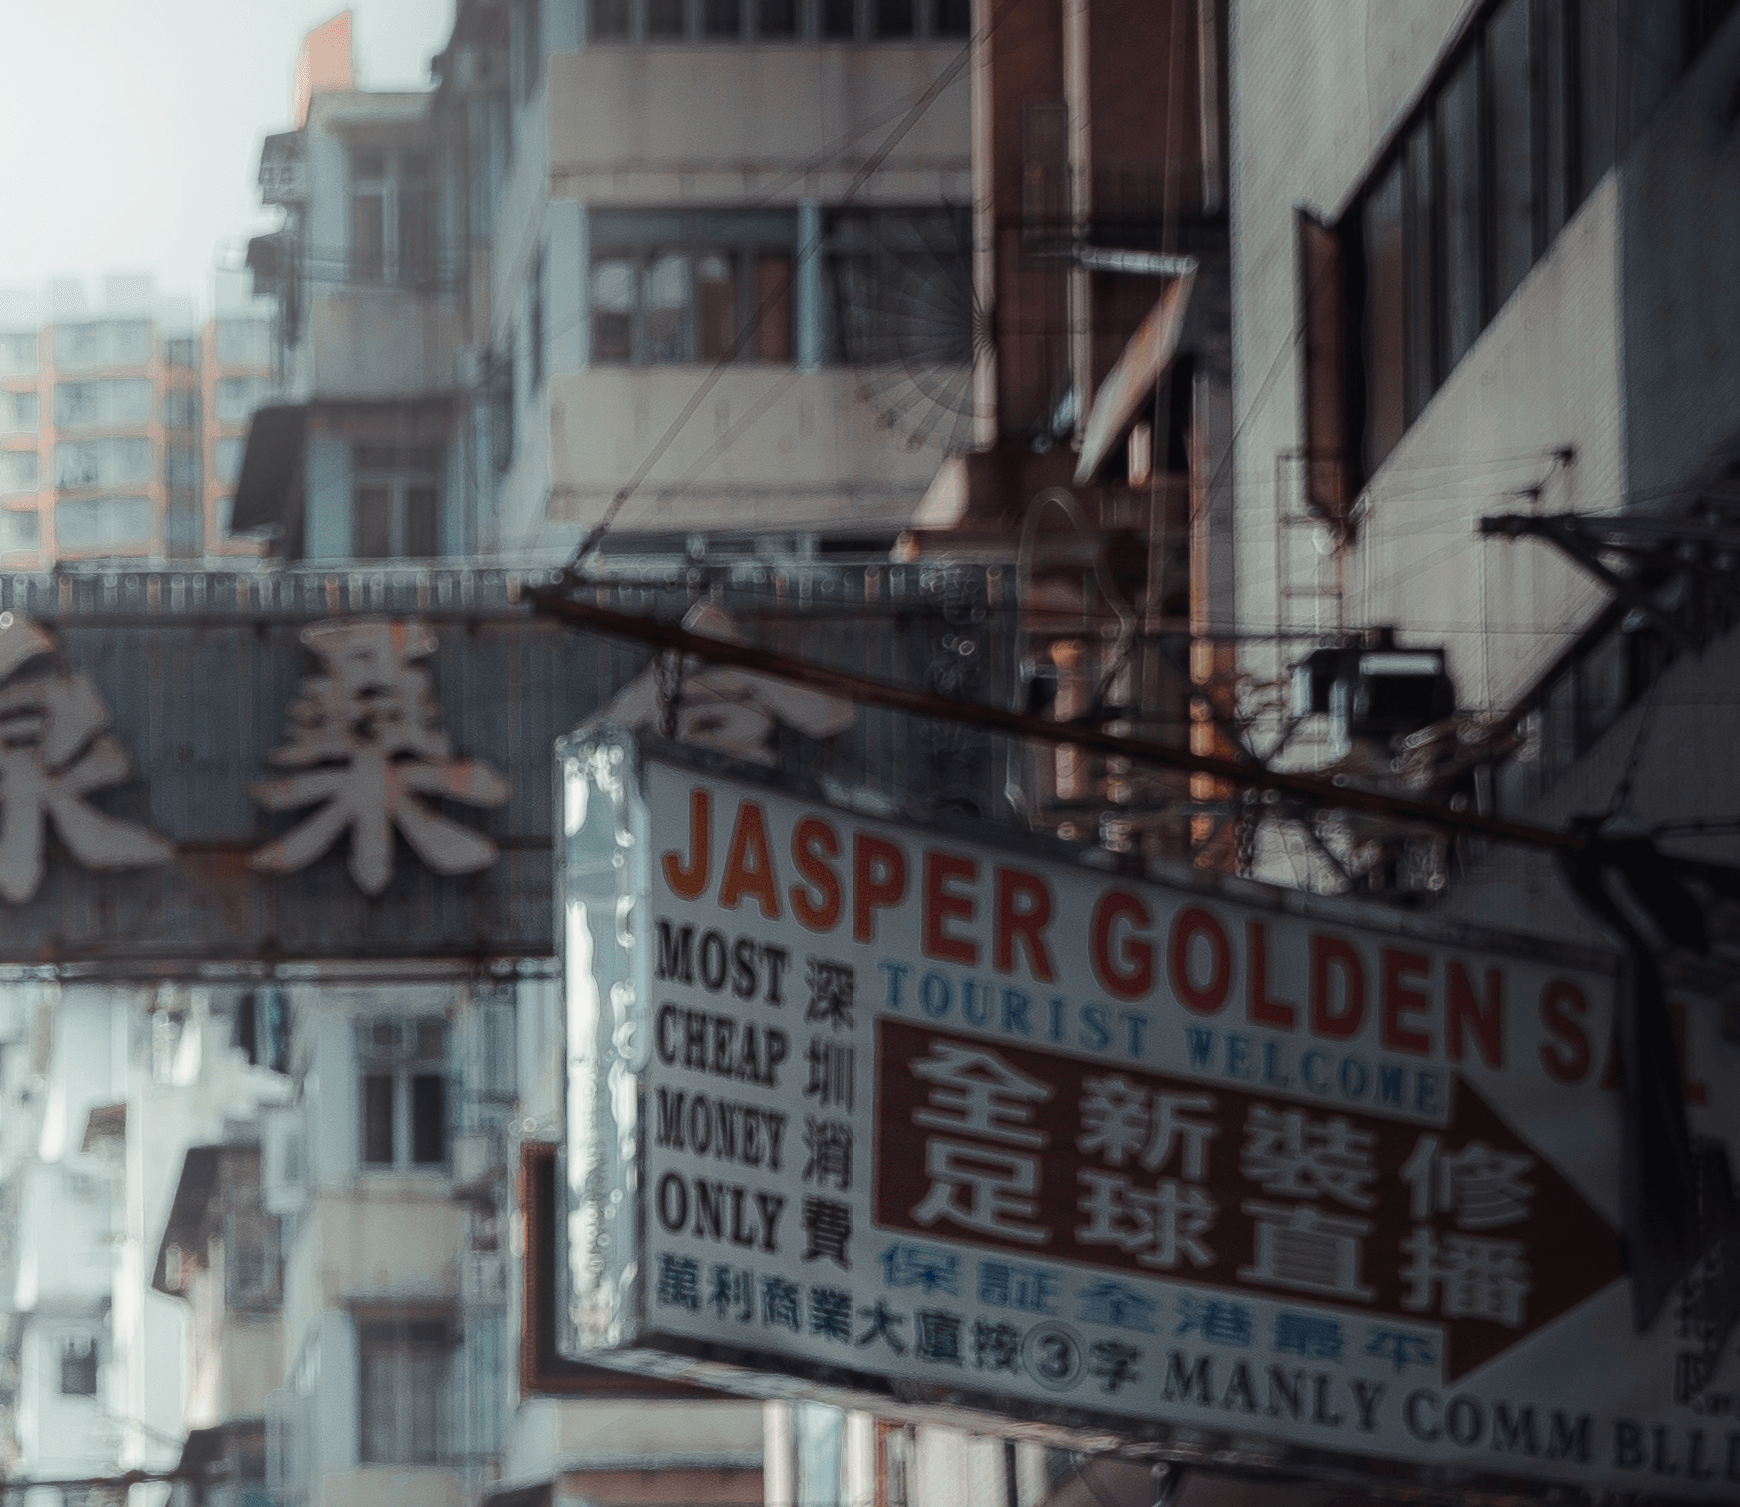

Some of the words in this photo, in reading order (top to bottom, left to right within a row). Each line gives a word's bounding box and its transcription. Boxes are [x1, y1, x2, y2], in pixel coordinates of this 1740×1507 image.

[655, 921, 789, 1007] MOST
[660, 788, 1058, 984] JASPER
[1087, 887, 1506, 1072] GOLDEN
[655, 1004, 789, 1088] CHEAP
[877, 960, 1150, 1059] TOURIST
[1184, 1024, 1444, 1114] WELCOME
[655, 1087, 788, 1174] MONEY
[801, 957, 856, 1273] 深圳消費
[908, 1038, 1536, 1231] 全新裝修
[656, 1171, 786, 1254] ONLY
[1163, 1352, 1386, 1434] MANLY
[1401, 1388, 1593, 1463] COMM
